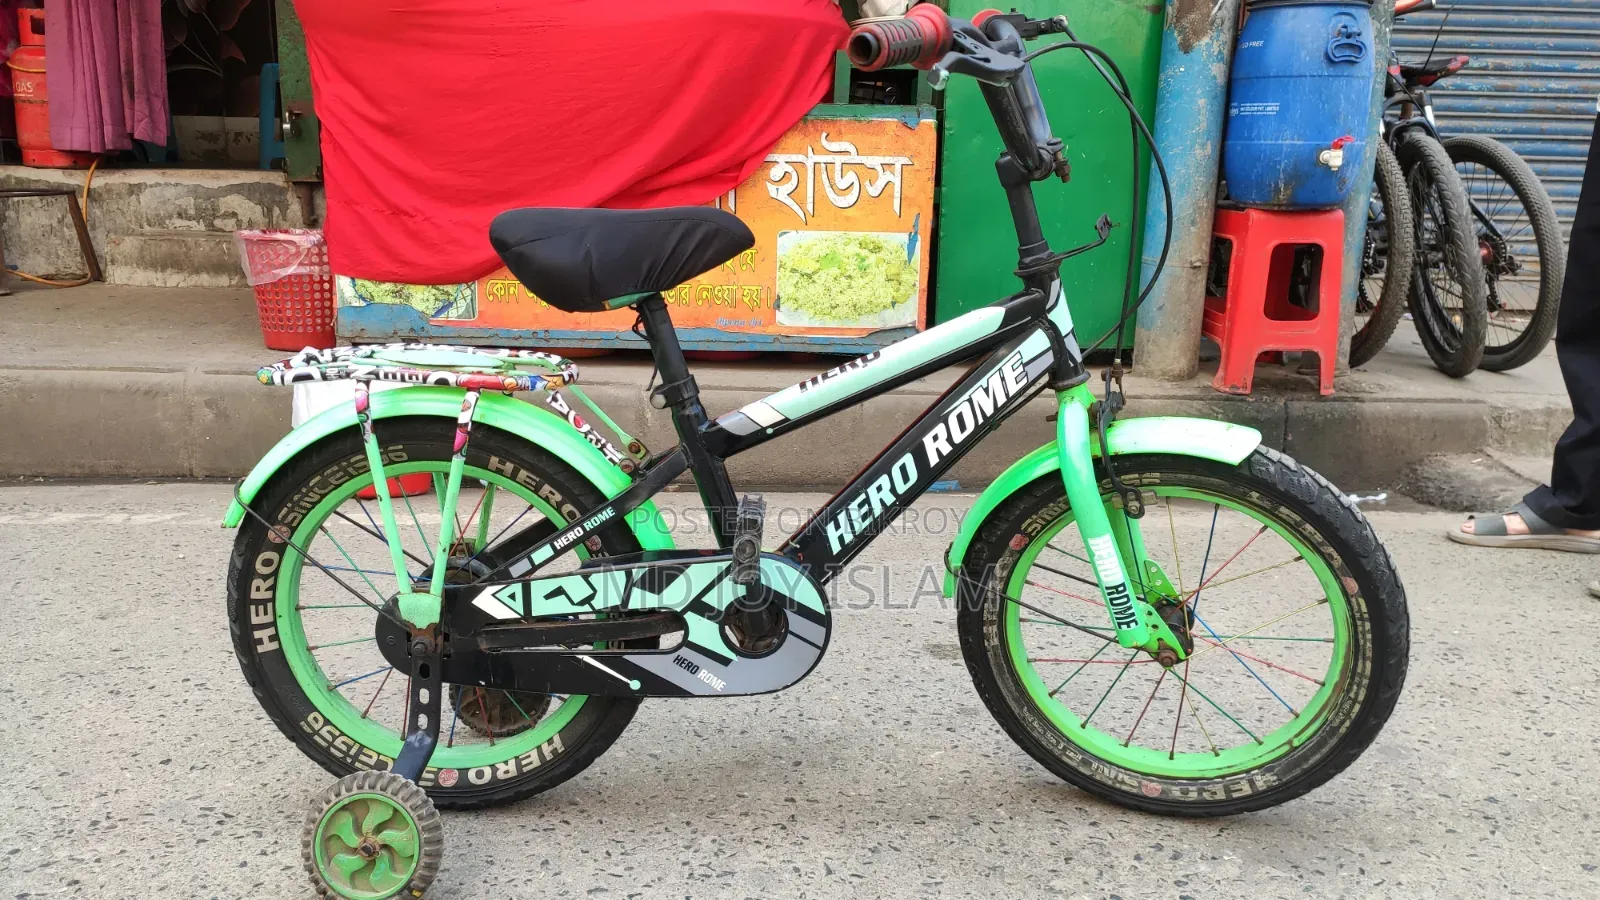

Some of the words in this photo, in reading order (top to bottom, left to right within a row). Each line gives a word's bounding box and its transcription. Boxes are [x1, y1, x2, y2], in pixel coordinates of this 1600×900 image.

[15, 81, 34, 93] GAS
[764, 132, 914, 225] হাউস
[483, 275, 521, 304] কোন
[824, 453, 919, 556] HERO
[922, 350, 1030, 468] ROME
[487, 455, 582, 523] HERO
[553, 526, 584, 550] HERO
[583, 506, 616, 532] ROME
[250, 551, 280, 653] HERO
[1104, 581, 1139, 630] ROME
[673, 654, 700, 675] HERO
[697, 669, 727, 692] ROME
[467, 732, 566, 786] HERO
